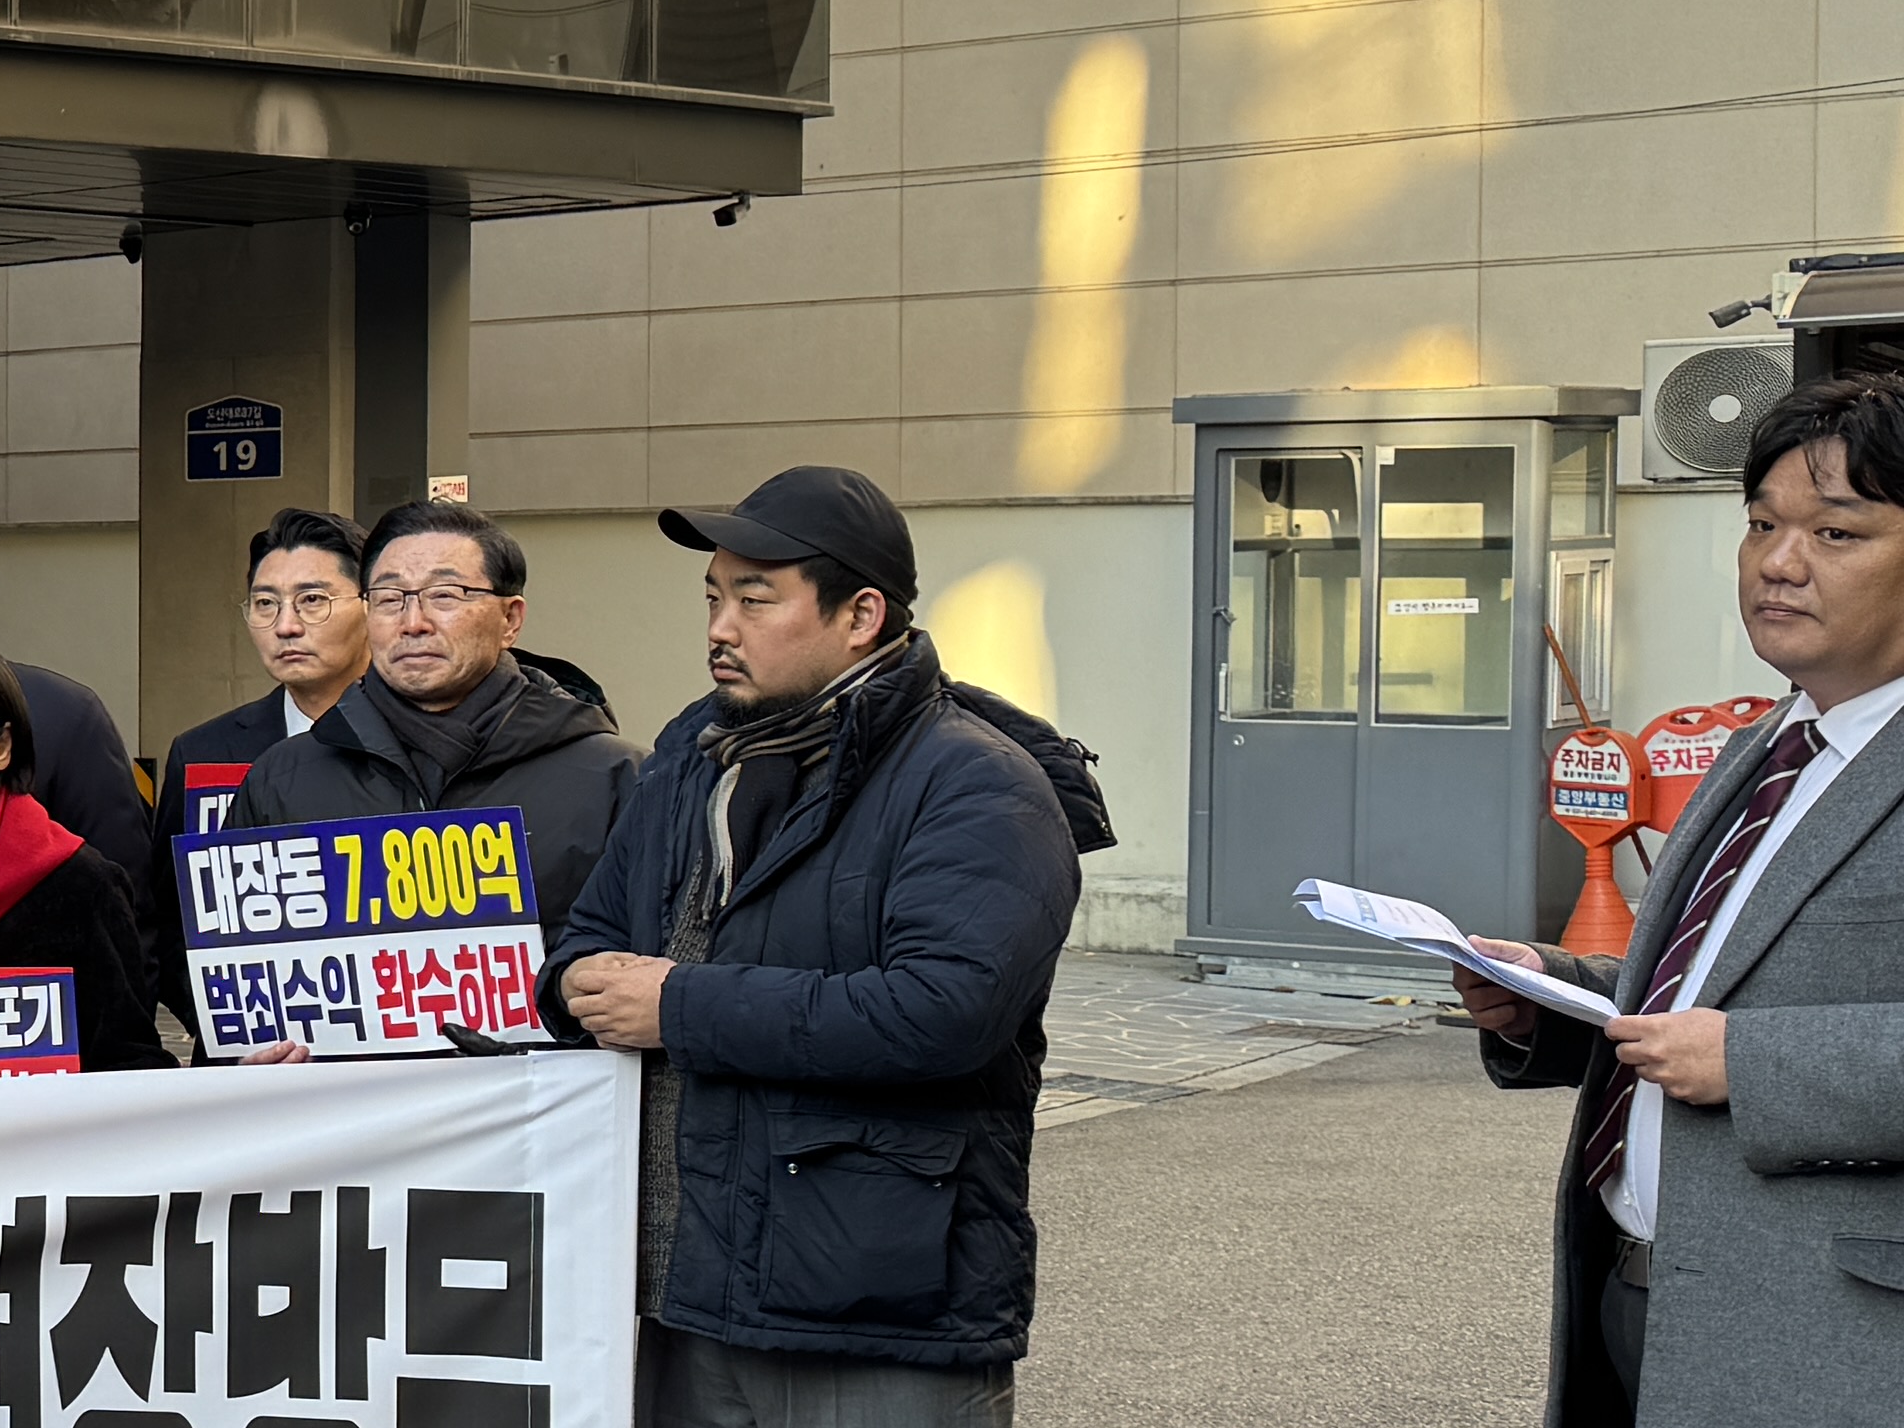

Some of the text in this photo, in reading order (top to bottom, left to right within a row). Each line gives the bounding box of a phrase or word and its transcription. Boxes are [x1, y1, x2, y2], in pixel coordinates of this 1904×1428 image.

[213, 439, 257, 471] 19
[1652, 746, 1722, 772] 주차금
[187, 821, 523, 935] 대장동 7,800억
[201, 941, 542, 1046] 범죄수익 환수하라
